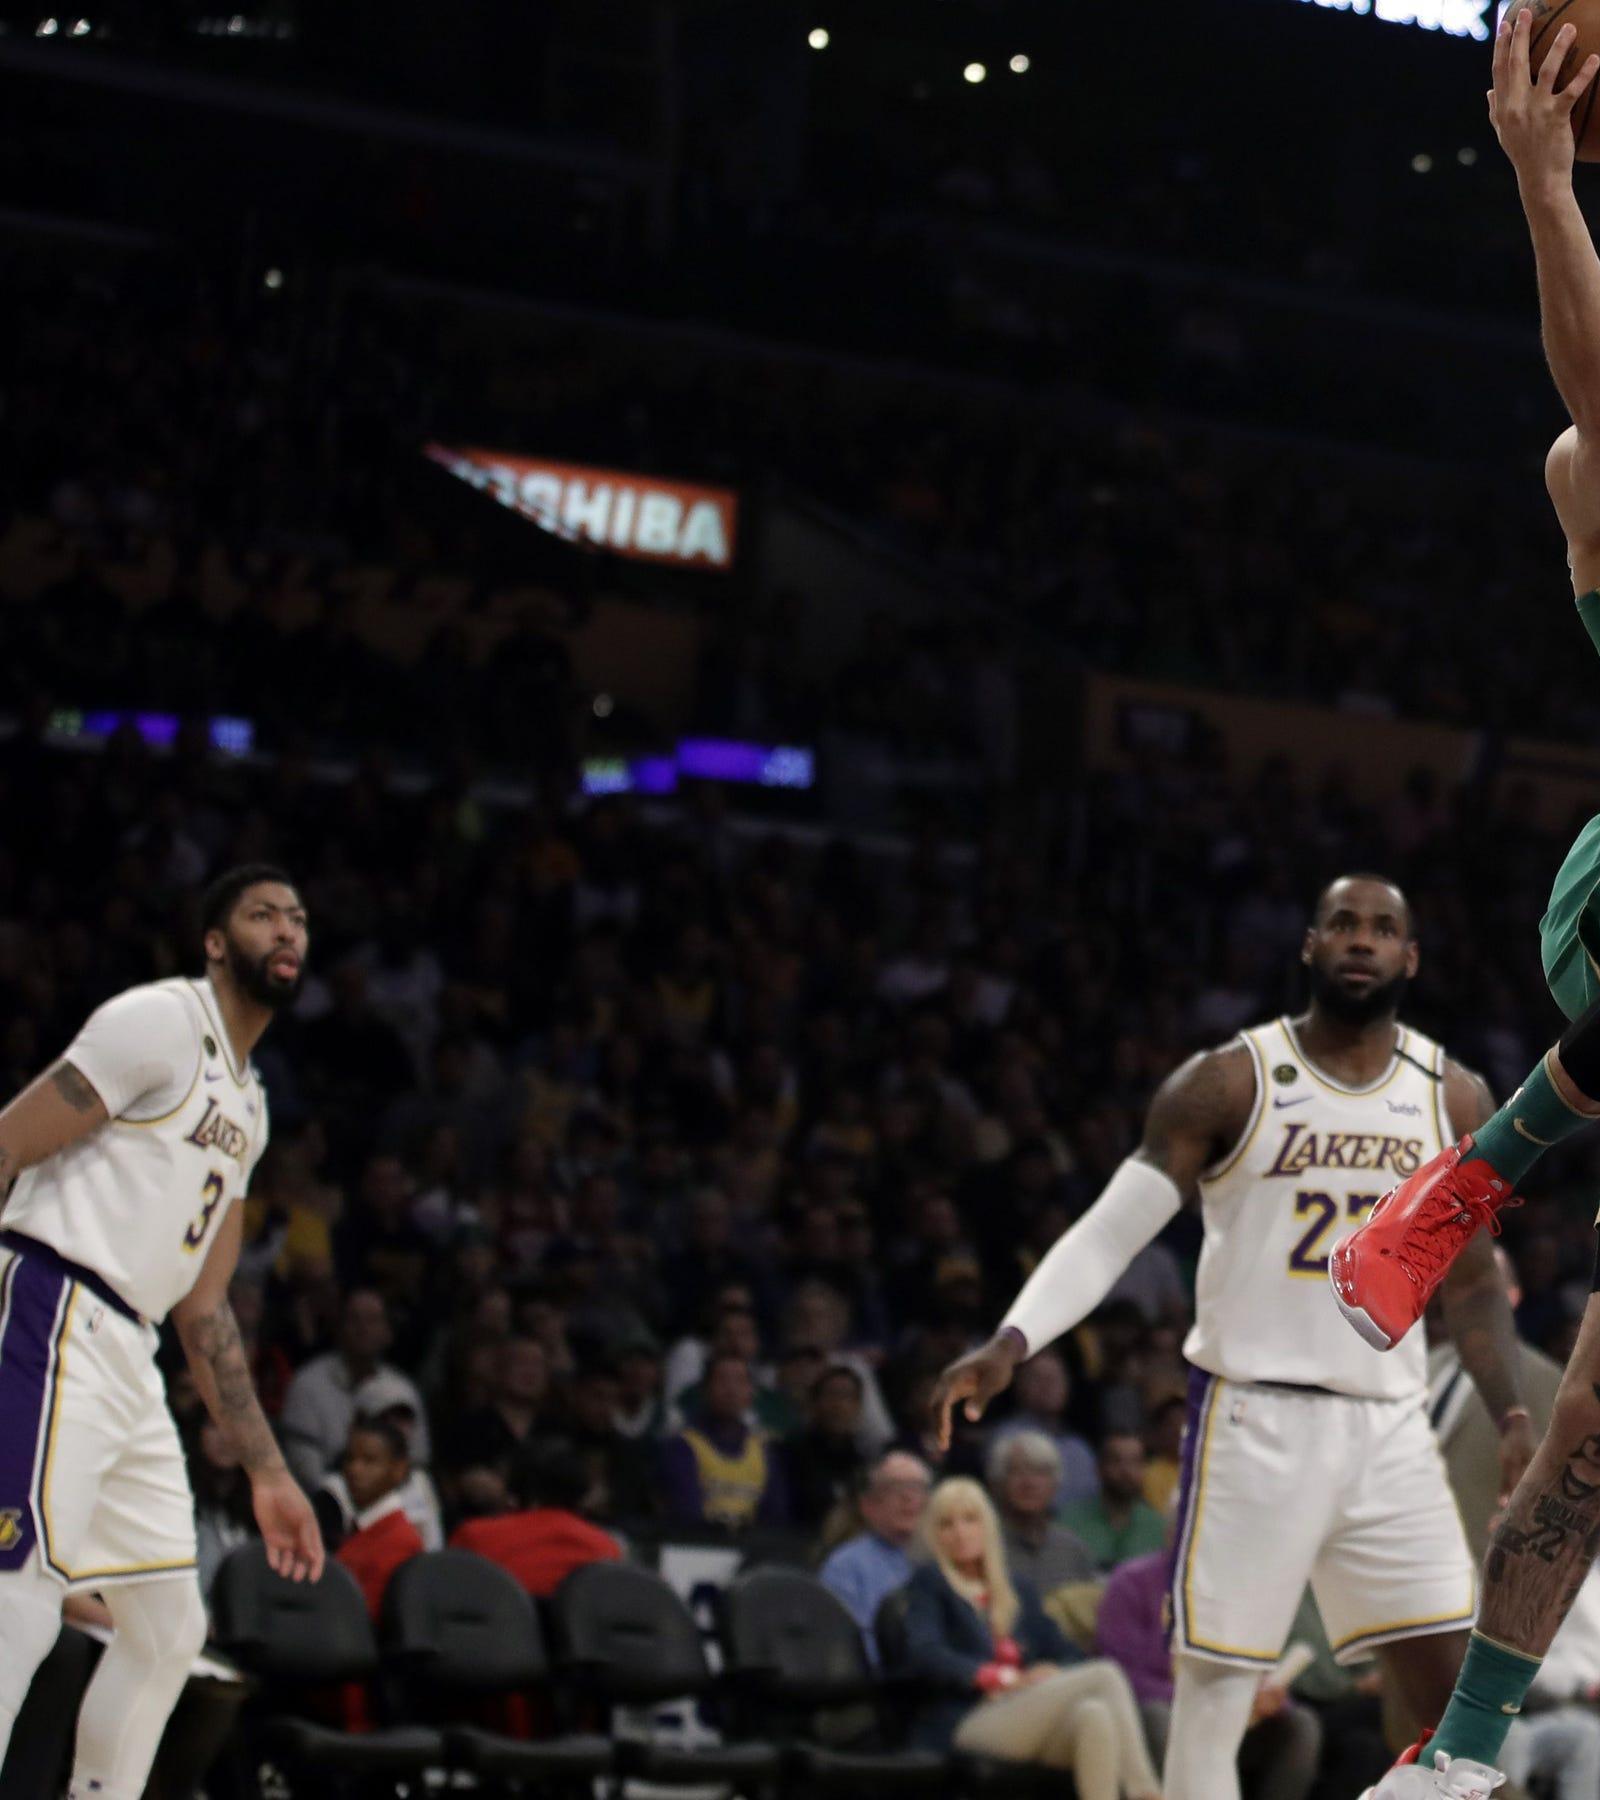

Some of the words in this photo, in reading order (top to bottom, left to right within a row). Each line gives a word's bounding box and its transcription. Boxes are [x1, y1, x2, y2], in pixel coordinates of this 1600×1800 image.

[1262, 1122, 1424, 1179] LAKERS
[182, 1169, 225, 1254] 3
[1287, 1190, 1382, 1279] 2
